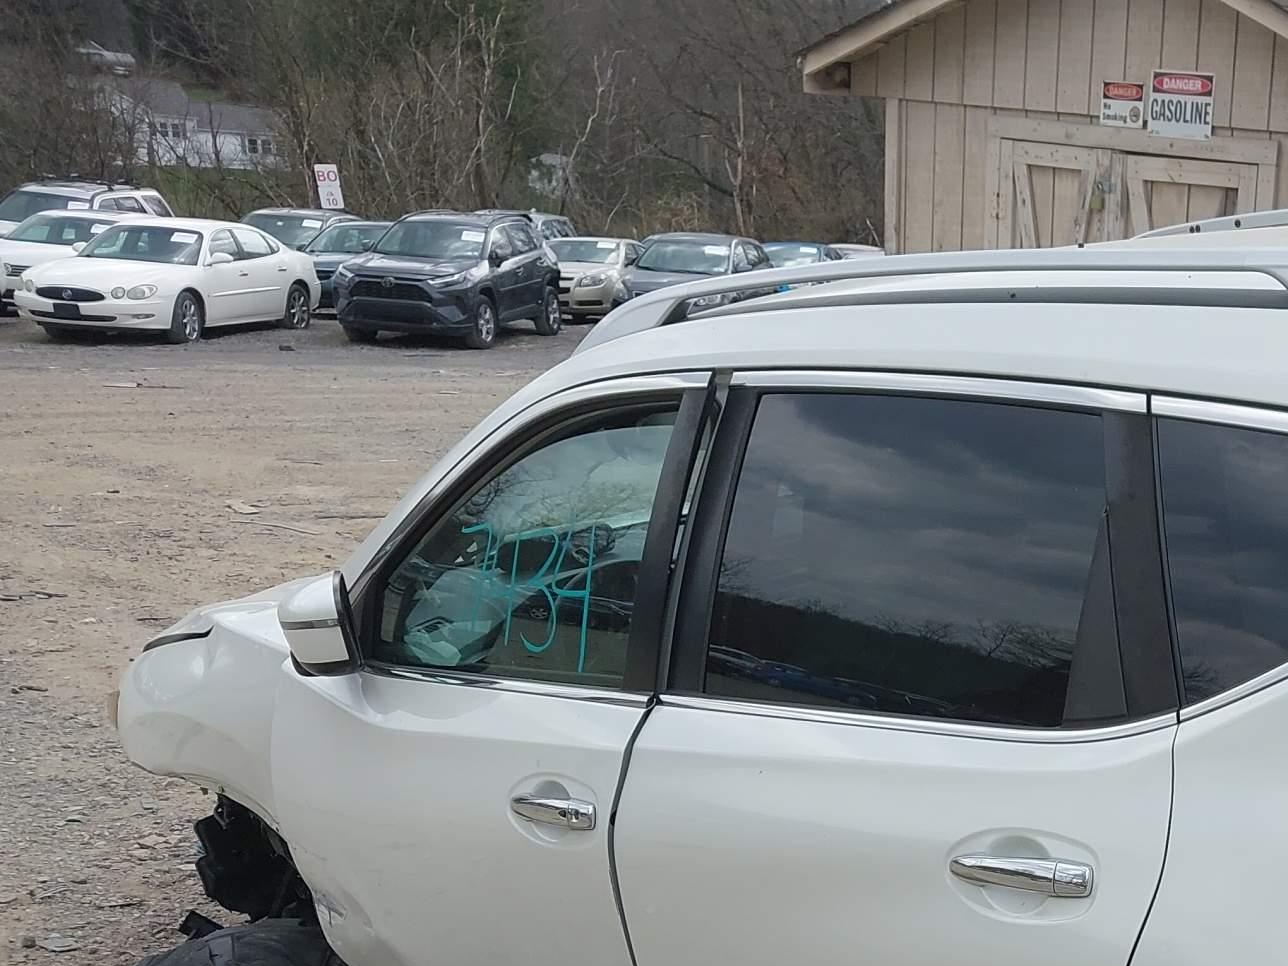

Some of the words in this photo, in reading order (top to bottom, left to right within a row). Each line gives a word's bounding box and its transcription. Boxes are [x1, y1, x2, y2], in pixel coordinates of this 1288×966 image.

[1162, 77, 1203, 91] DANGER
[1108, 86, 1137, 97] DANGER
[1102, 111, 1128, 124] Smoking
[1150, 98, 1211, 125] GASOLINE
